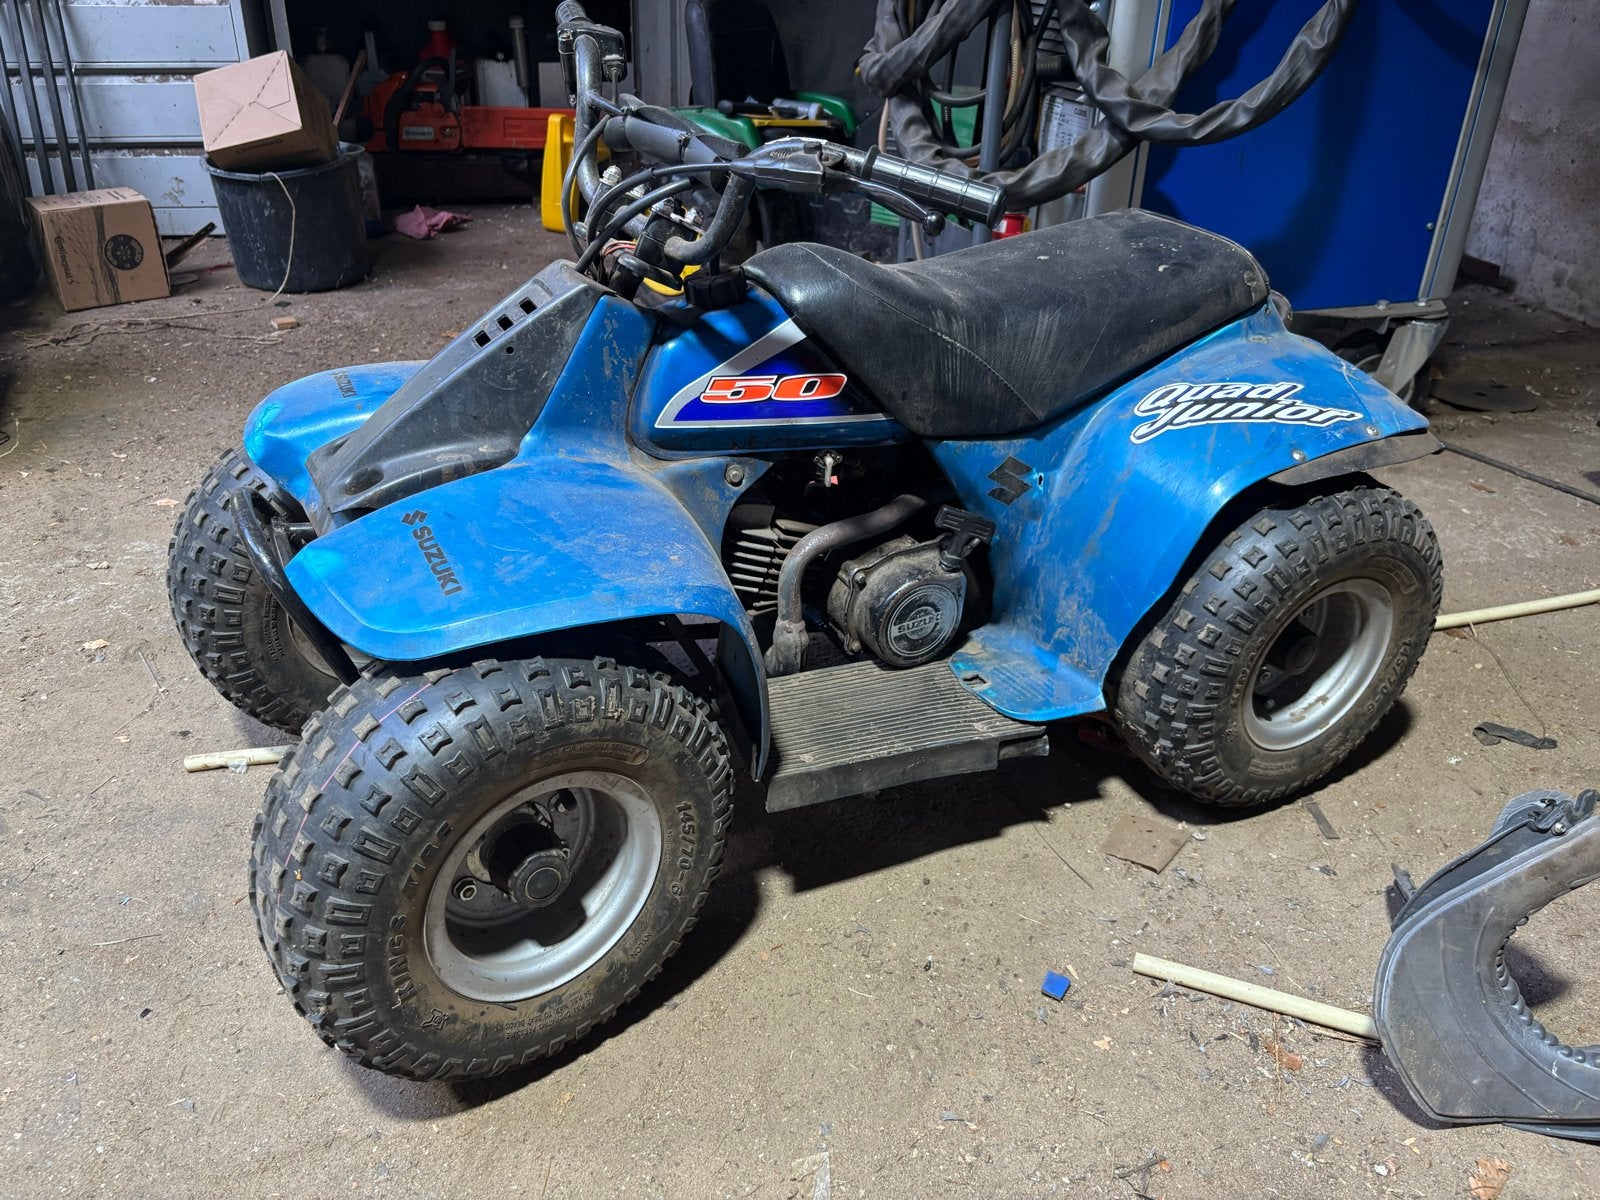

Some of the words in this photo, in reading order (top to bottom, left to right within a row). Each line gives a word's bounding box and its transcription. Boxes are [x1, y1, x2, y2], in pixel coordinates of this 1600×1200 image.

[335, 374, 358, 398] SUZUKI
[700, 373, 848, 404] 50
[1134, 382, 1304, 417] Quad
[1130, 398, 1364, 445] Junior
[412, 525, 463, 597] SUZUKI
[671, 801, 696, 897] 145/70-6
[387, 914, 417, 1002] KINGS
[631, 932, 653, 960] NYLON
[544, 1010, 552, 1019] TO
